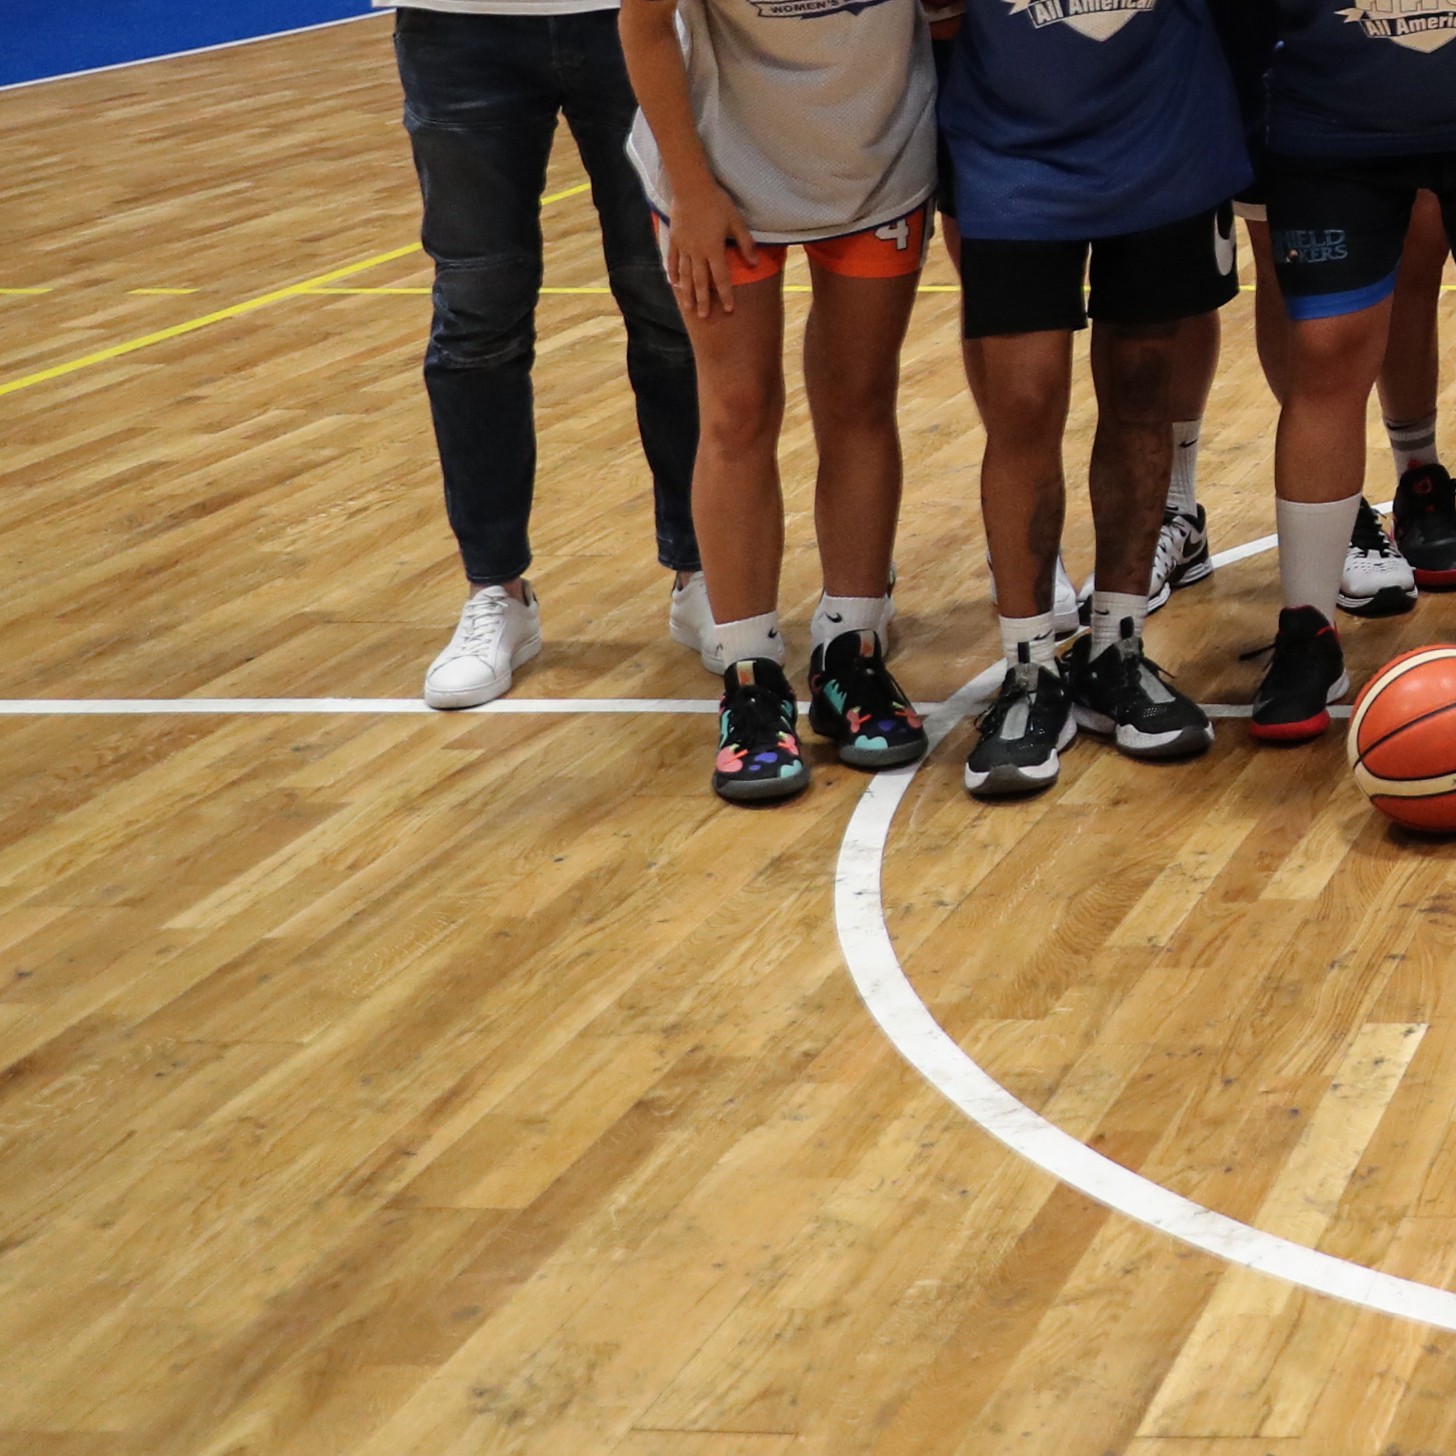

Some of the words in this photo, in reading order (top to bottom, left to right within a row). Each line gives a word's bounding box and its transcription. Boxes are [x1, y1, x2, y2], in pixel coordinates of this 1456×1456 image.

[771, 0, 840, 13] WOMEN'S
[1365, 19, 1391, 37] All
[874, 218, 909, 250] 4
